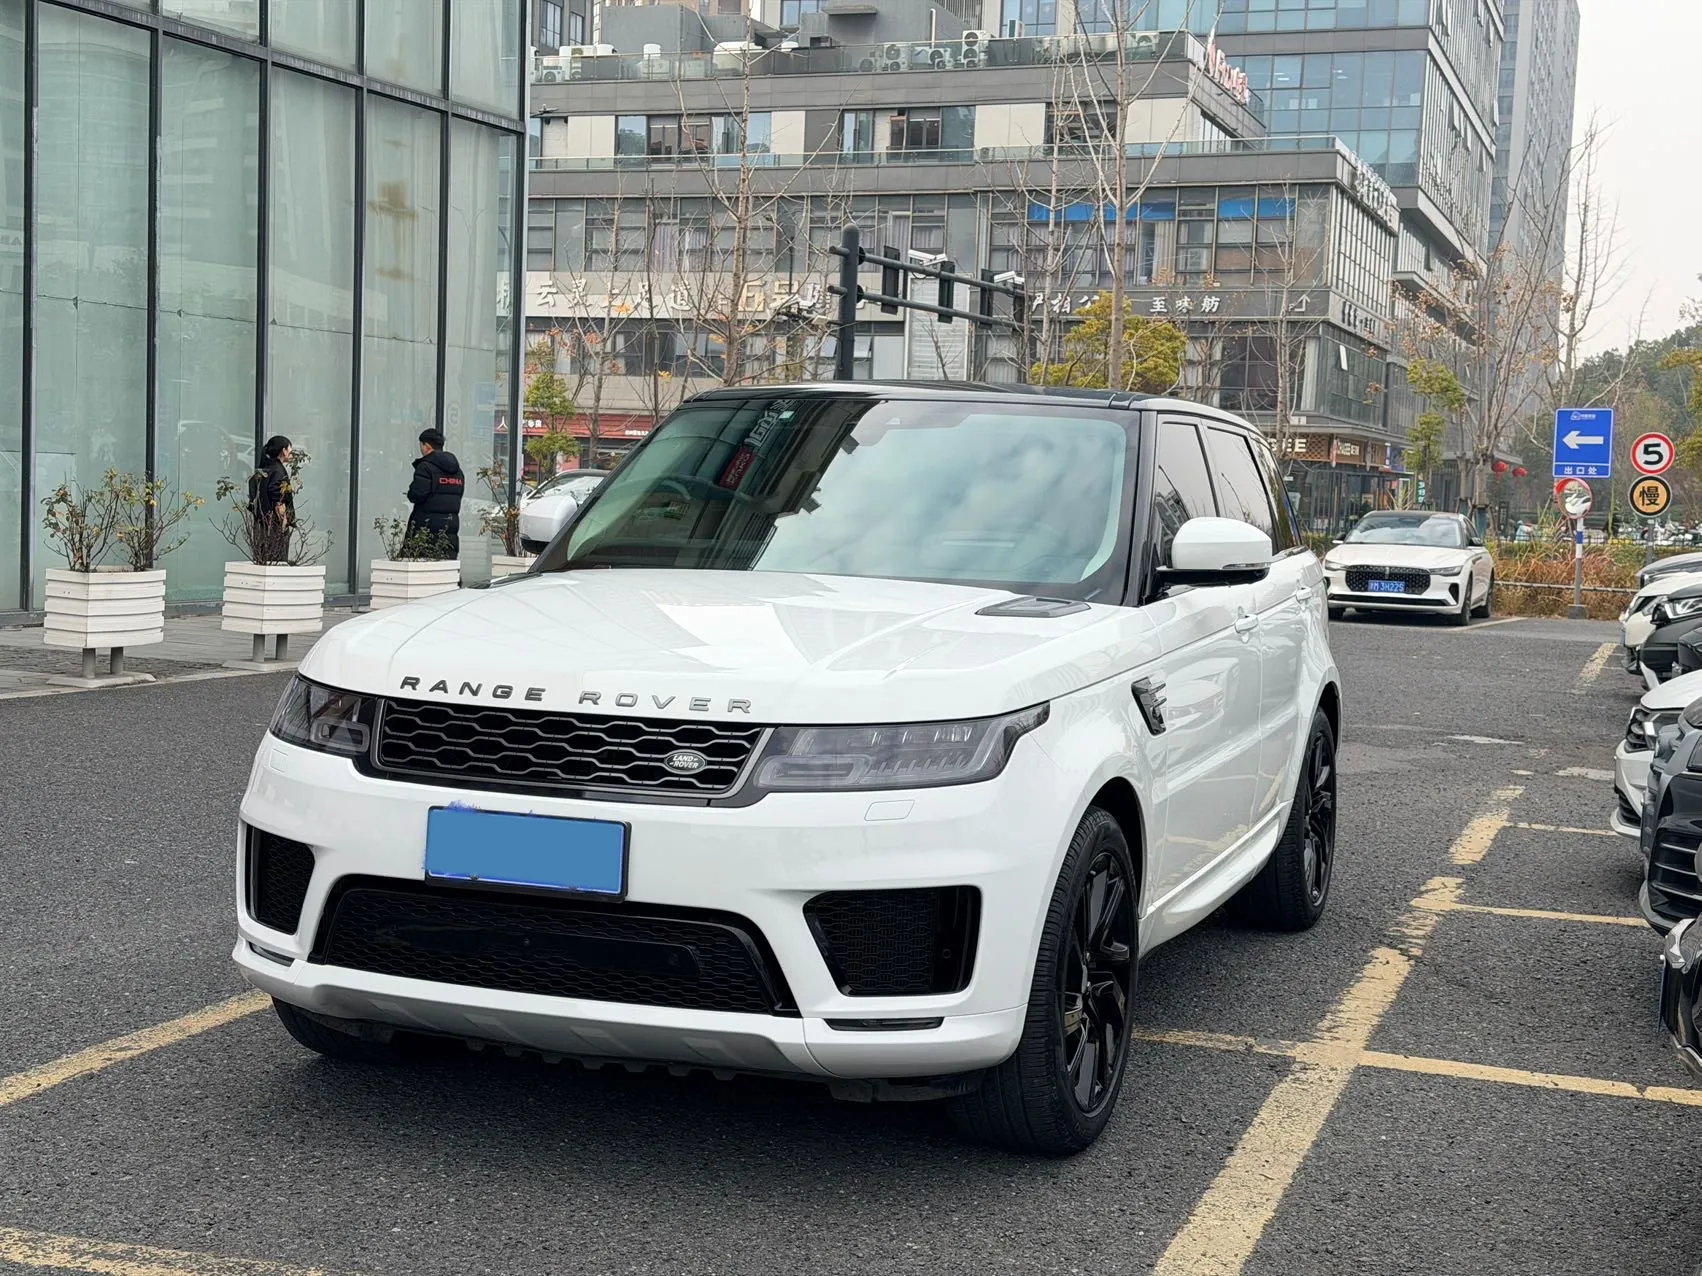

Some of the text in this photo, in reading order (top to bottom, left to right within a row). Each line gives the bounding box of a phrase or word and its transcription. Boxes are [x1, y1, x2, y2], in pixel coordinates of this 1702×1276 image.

[1643, 443, 1664, 466] 5
[1563, 466, 1598, 475] 出口处
[1638, 485, 1660, 507] 慢
[400, 676, 752, 714] RANGE ROVER
[672, 754, 694, 762] LAND
[673, 761, 699, 769] ROVER
